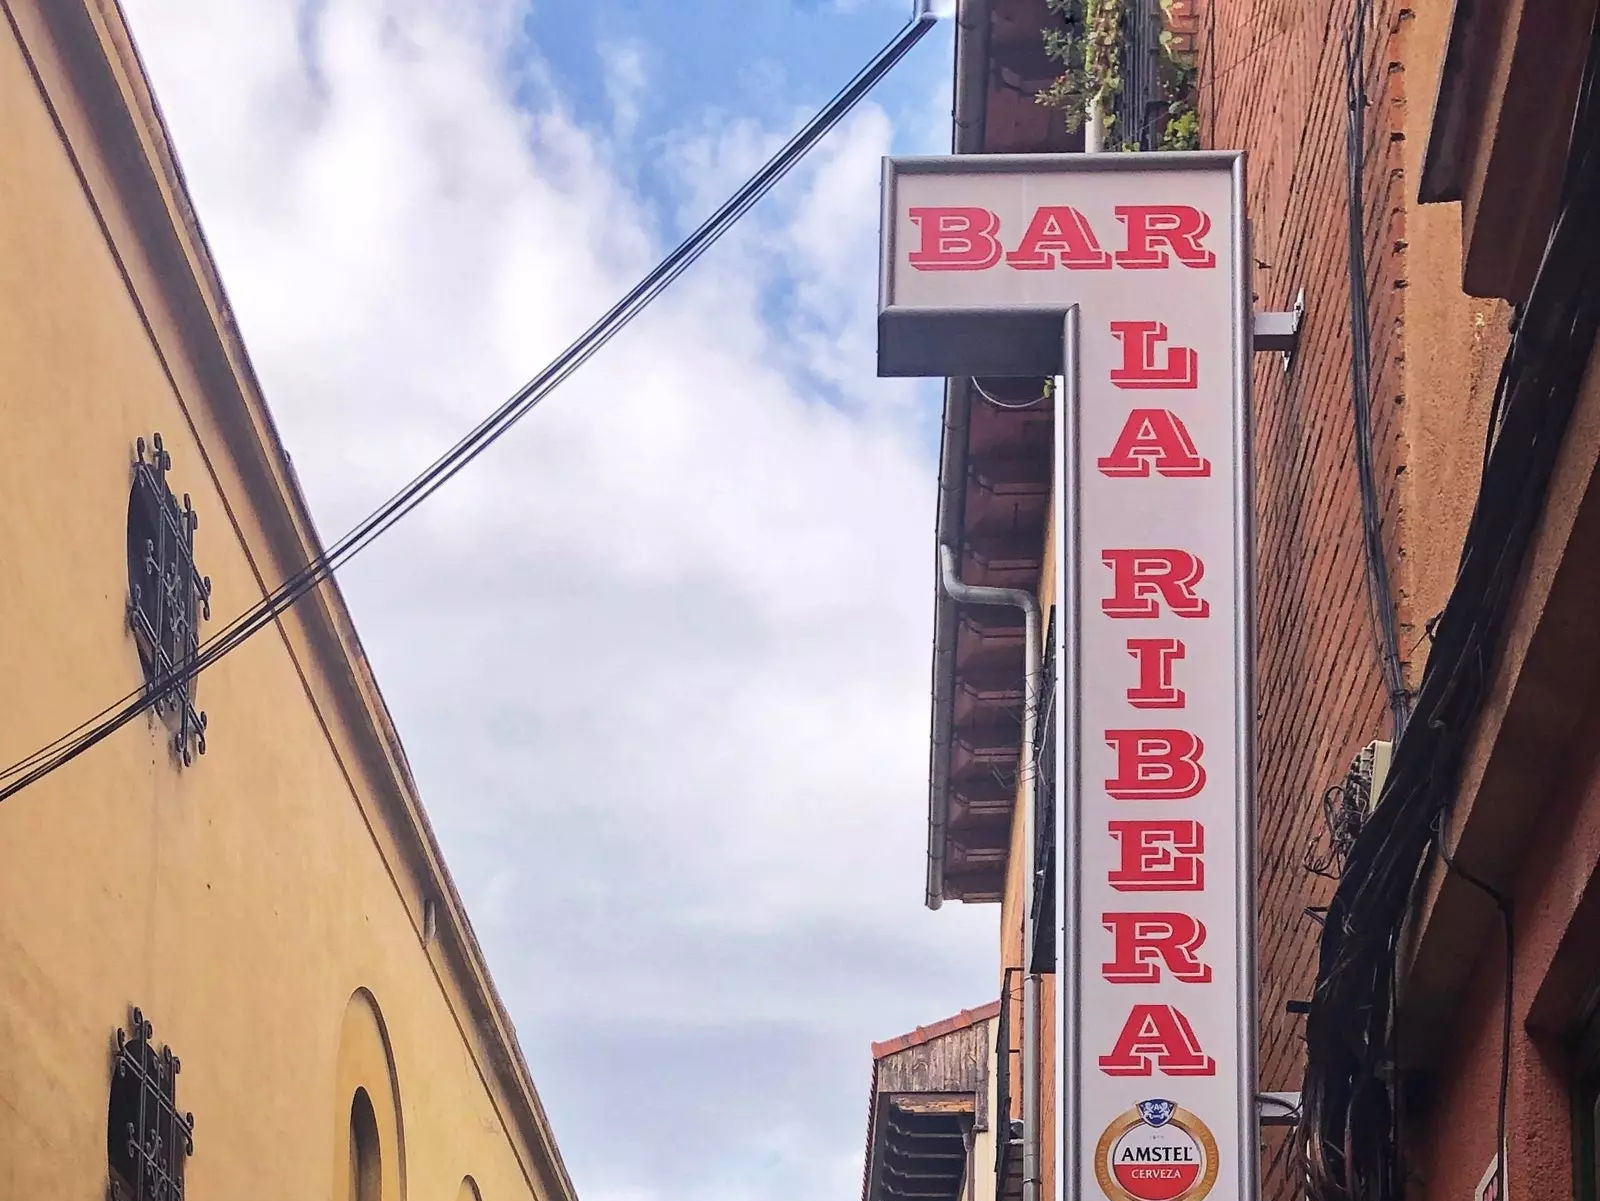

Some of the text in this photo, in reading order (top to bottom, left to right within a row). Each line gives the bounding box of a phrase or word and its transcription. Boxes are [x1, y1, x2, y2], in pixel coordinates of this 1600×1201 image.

[908, 205, 1217, 271] BAR
[1097, 320, 1212, 478] LA
[1098, 547, 1217, 1078] RIBERA
[1121, 1146, 1193, 1162] AMSTEL
[1131, 1168, 1182, 1179] CERVEZA
